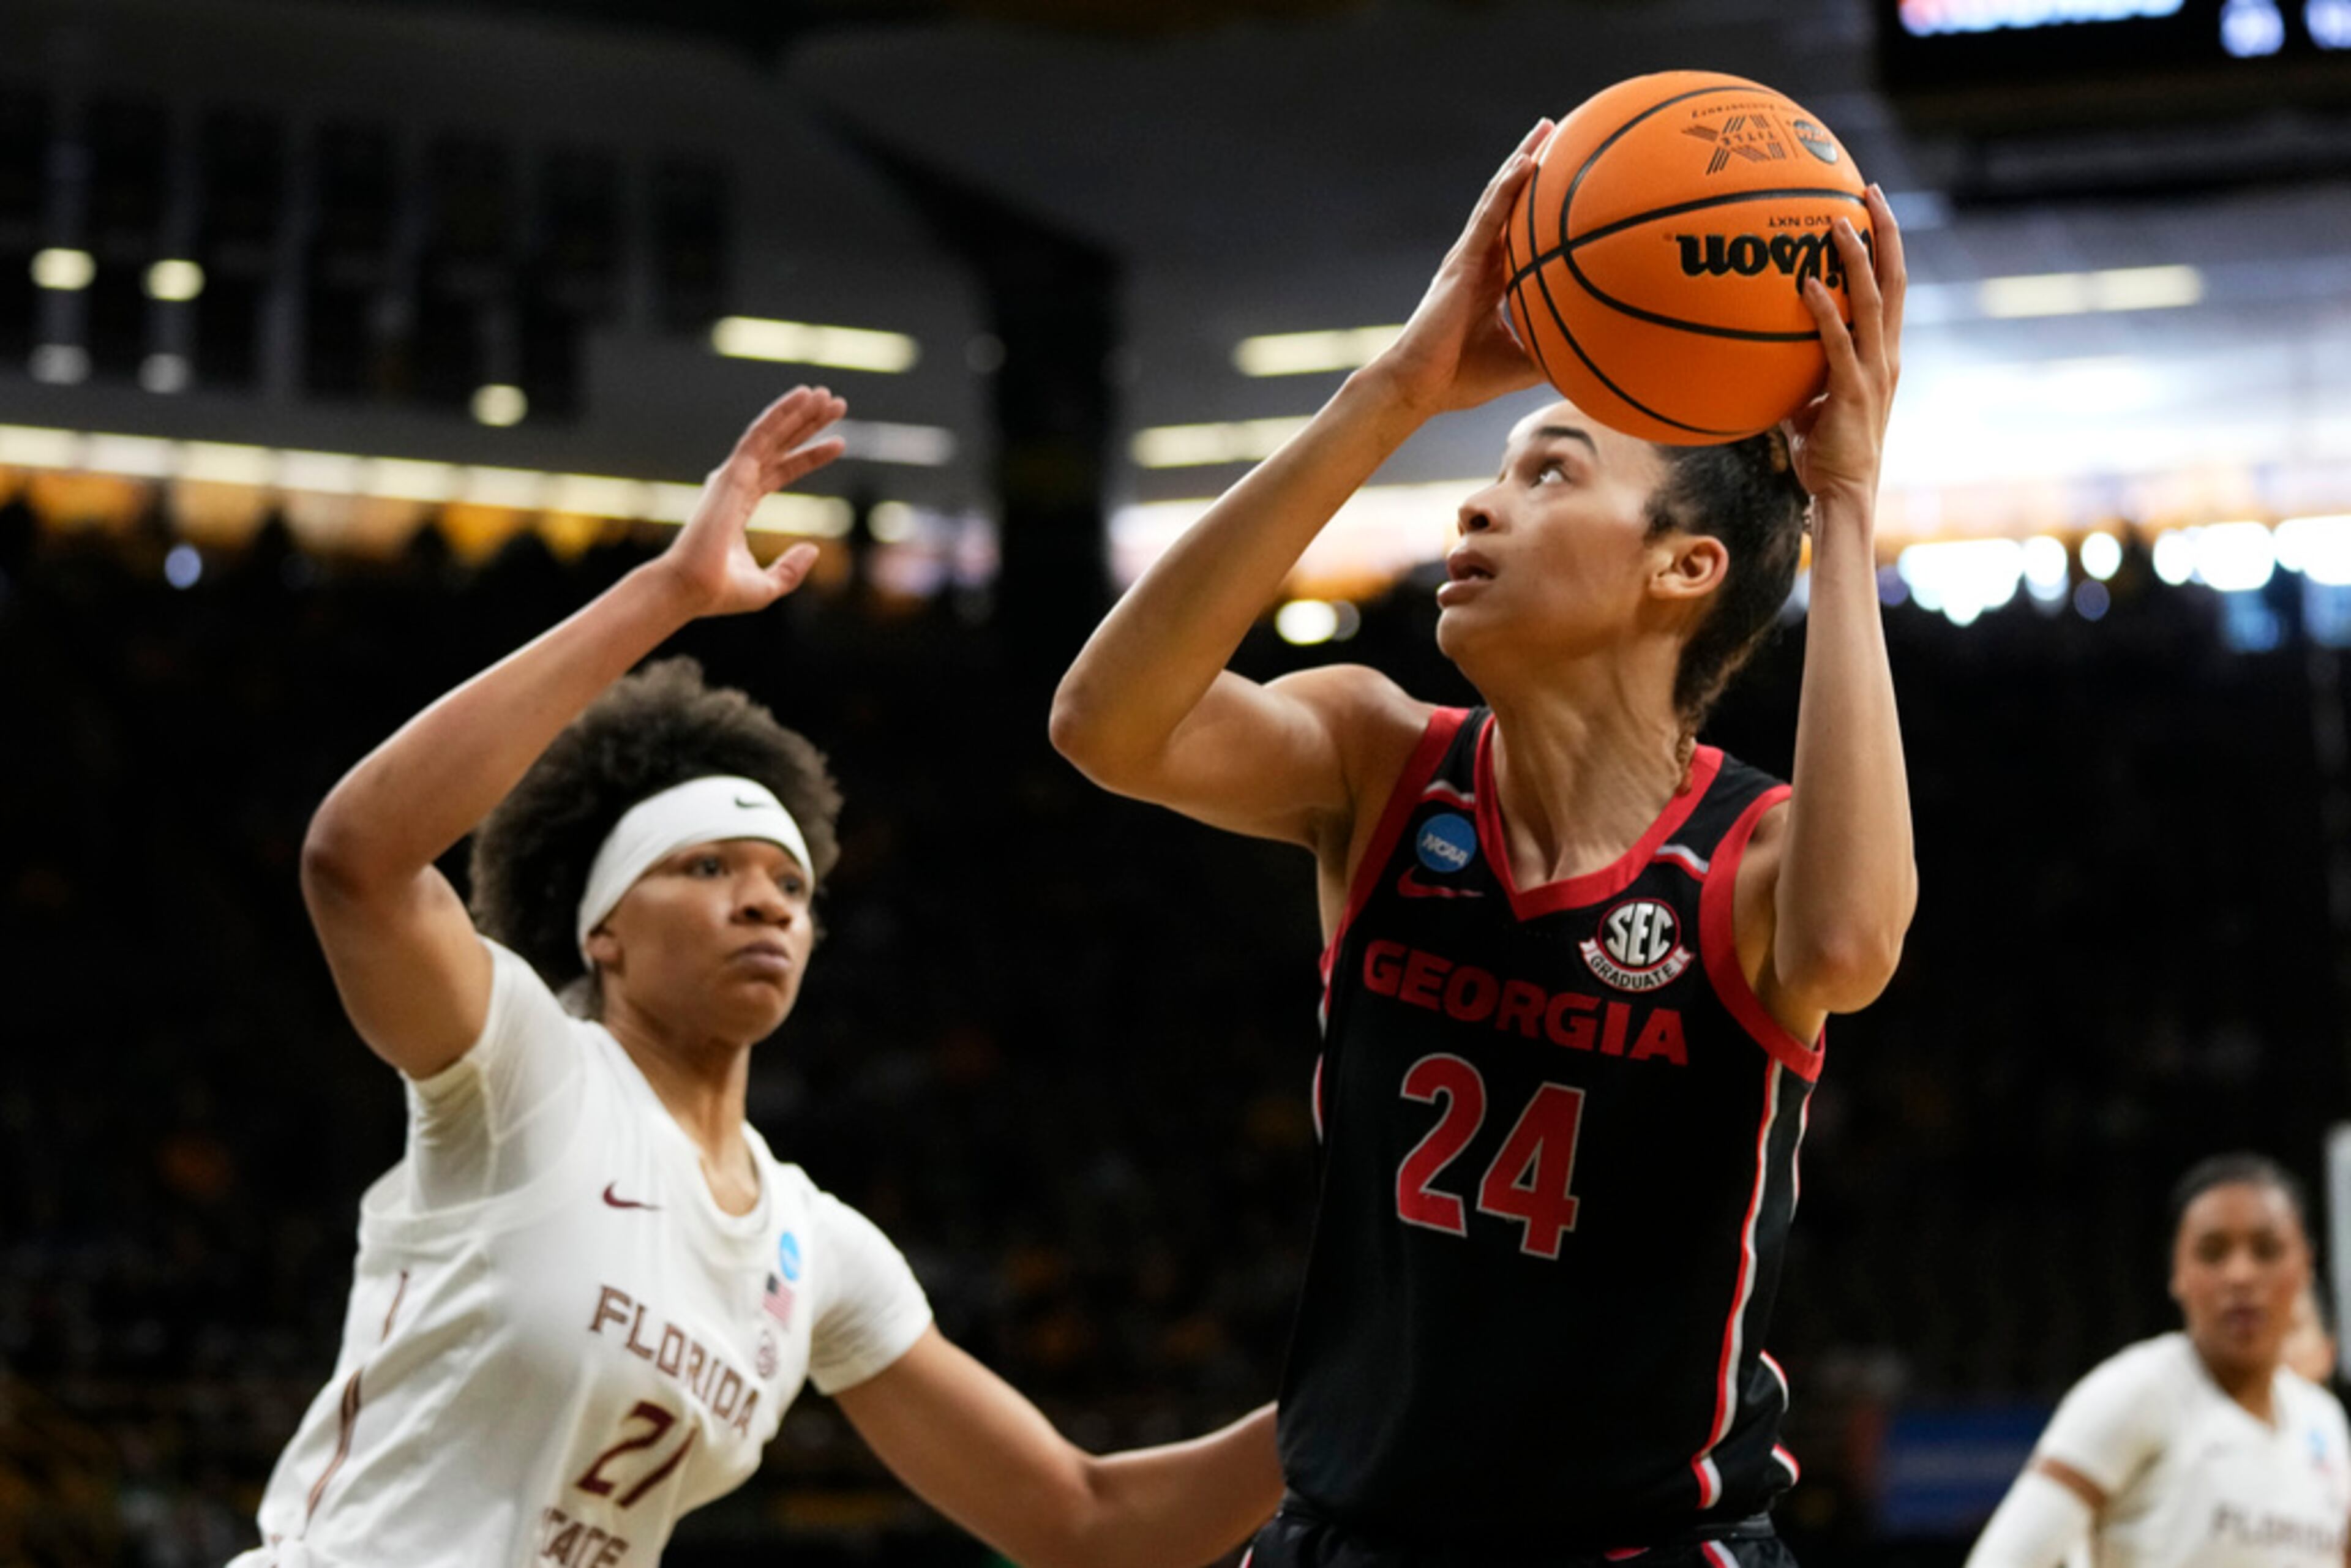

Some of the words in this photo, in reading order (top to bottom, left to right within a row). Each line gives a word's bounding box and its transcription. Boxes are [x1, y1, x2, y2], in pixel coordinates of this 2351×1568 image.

[1769, 217, 1801, 228] NXT
[1423, 833, 1468, 867] NCAA
[1607, 902, 1674, 966] SEC
[1363, 939, 1689, 1065] GEORGIA
[1591, 955, 1674, 988] GRADUATE
[1396, 1052, 1586, 1260] 24
[589, 1285, 760, 1438] FLORIDA
[541, 1507, 629, 1568] TATE
